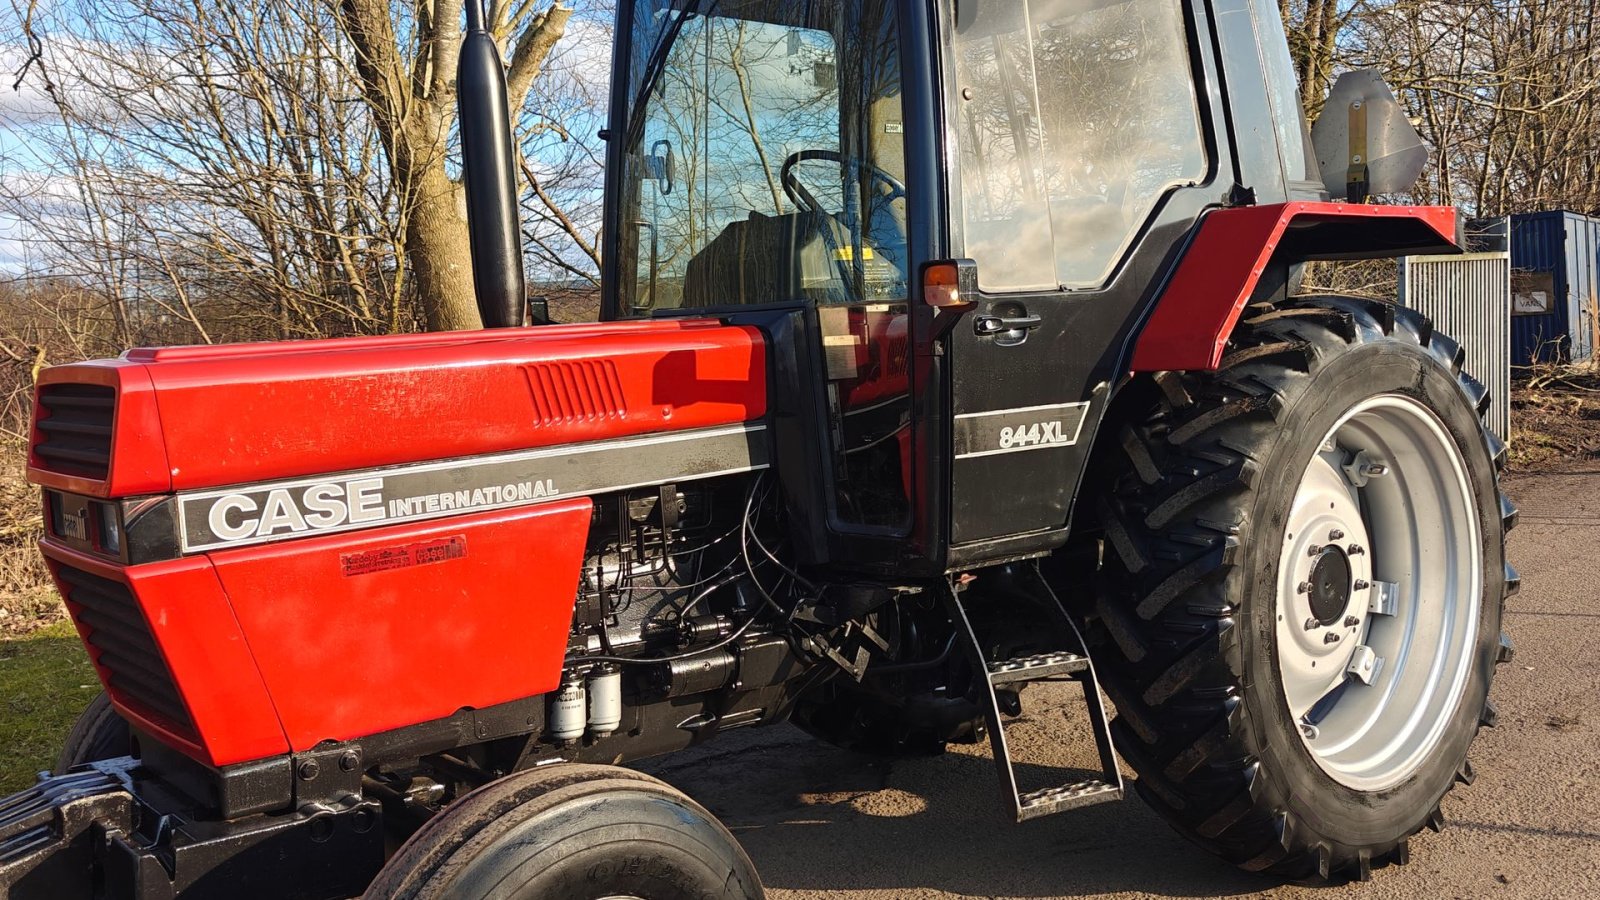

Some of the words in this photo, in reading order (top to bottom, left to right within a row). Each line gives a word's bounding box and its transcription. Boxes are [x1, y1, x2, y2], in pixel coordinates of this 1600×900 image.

[1000, 421, 1067, 449] 844XL
[208, 477, 386, 541] CASE
[389, 479, 559, 518] INTERNATIONAL
